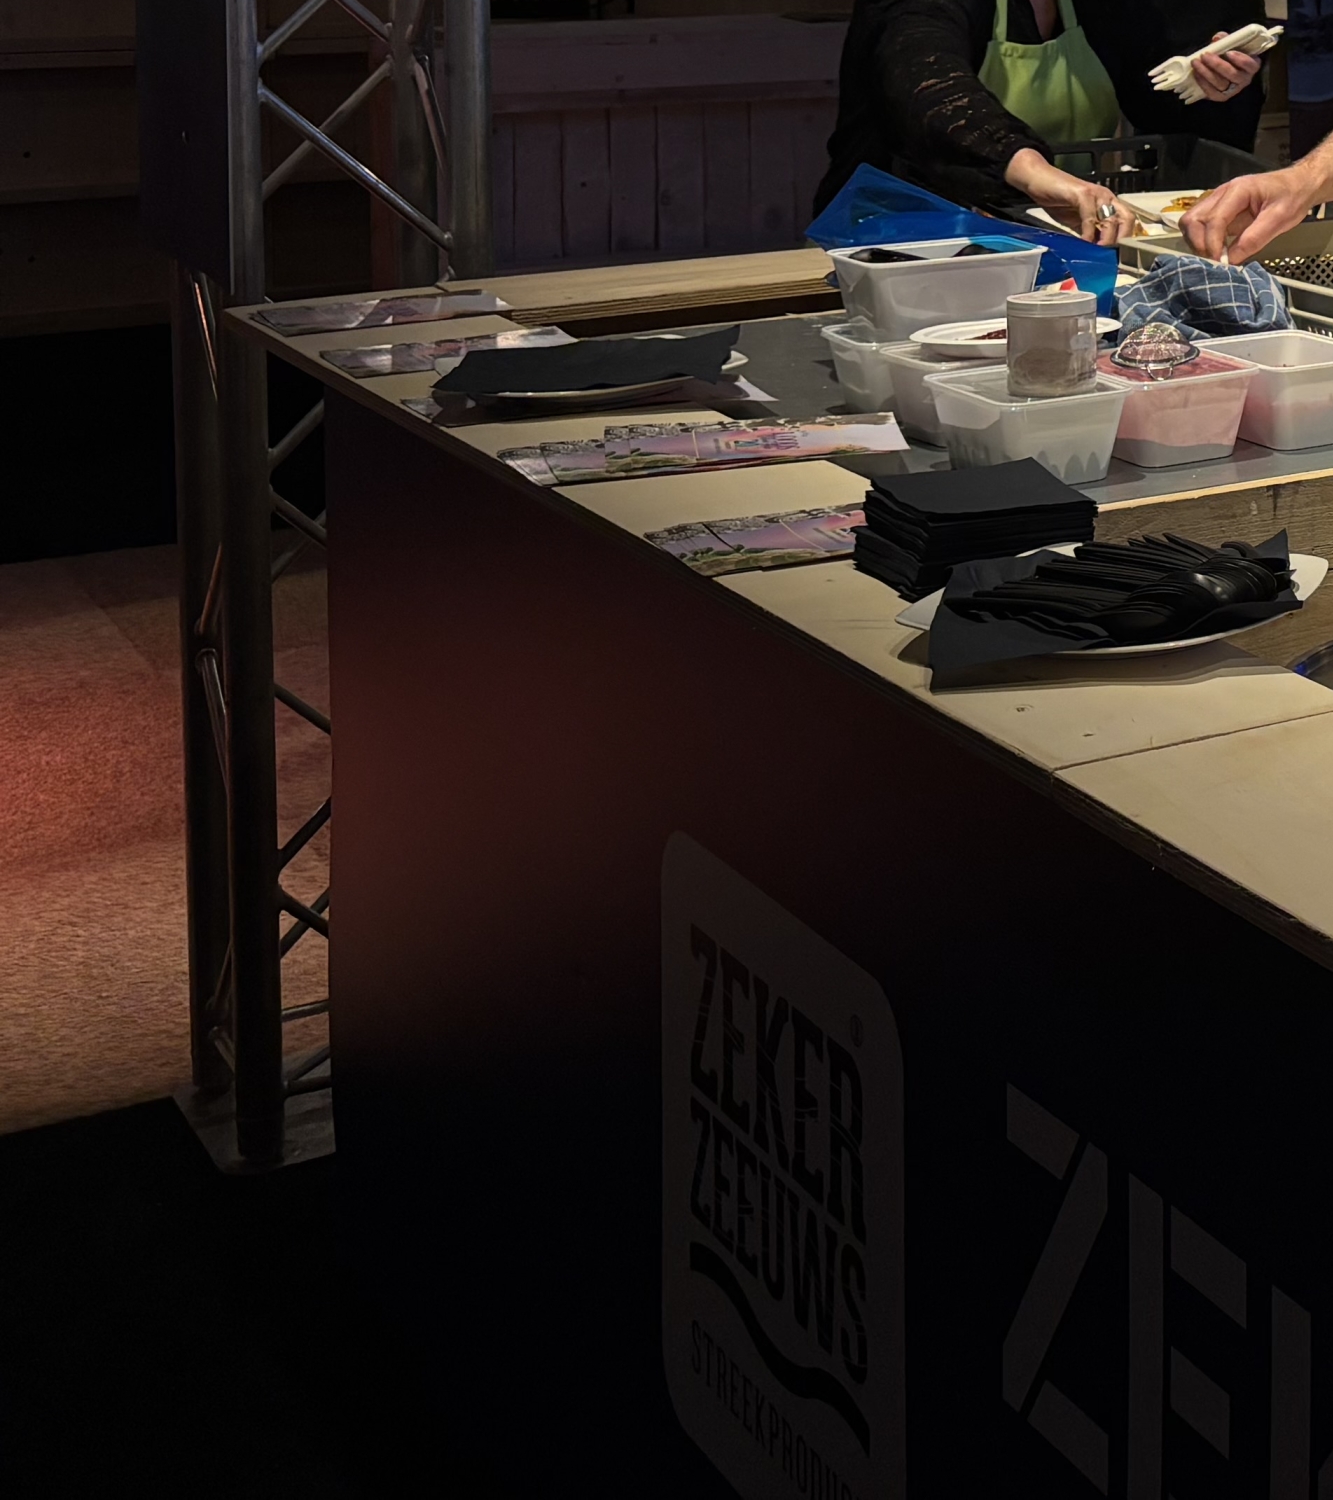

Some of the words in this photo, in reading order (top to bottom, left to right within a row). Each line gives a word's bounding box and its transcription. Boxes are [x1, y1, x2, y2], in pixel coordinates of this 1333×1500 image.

[690, 921, 867, 1245] ZEKER
[690, 1096, 868, 1385] ZEEUWS
[691, 1319, 860, 1500] STREEKPRODU
